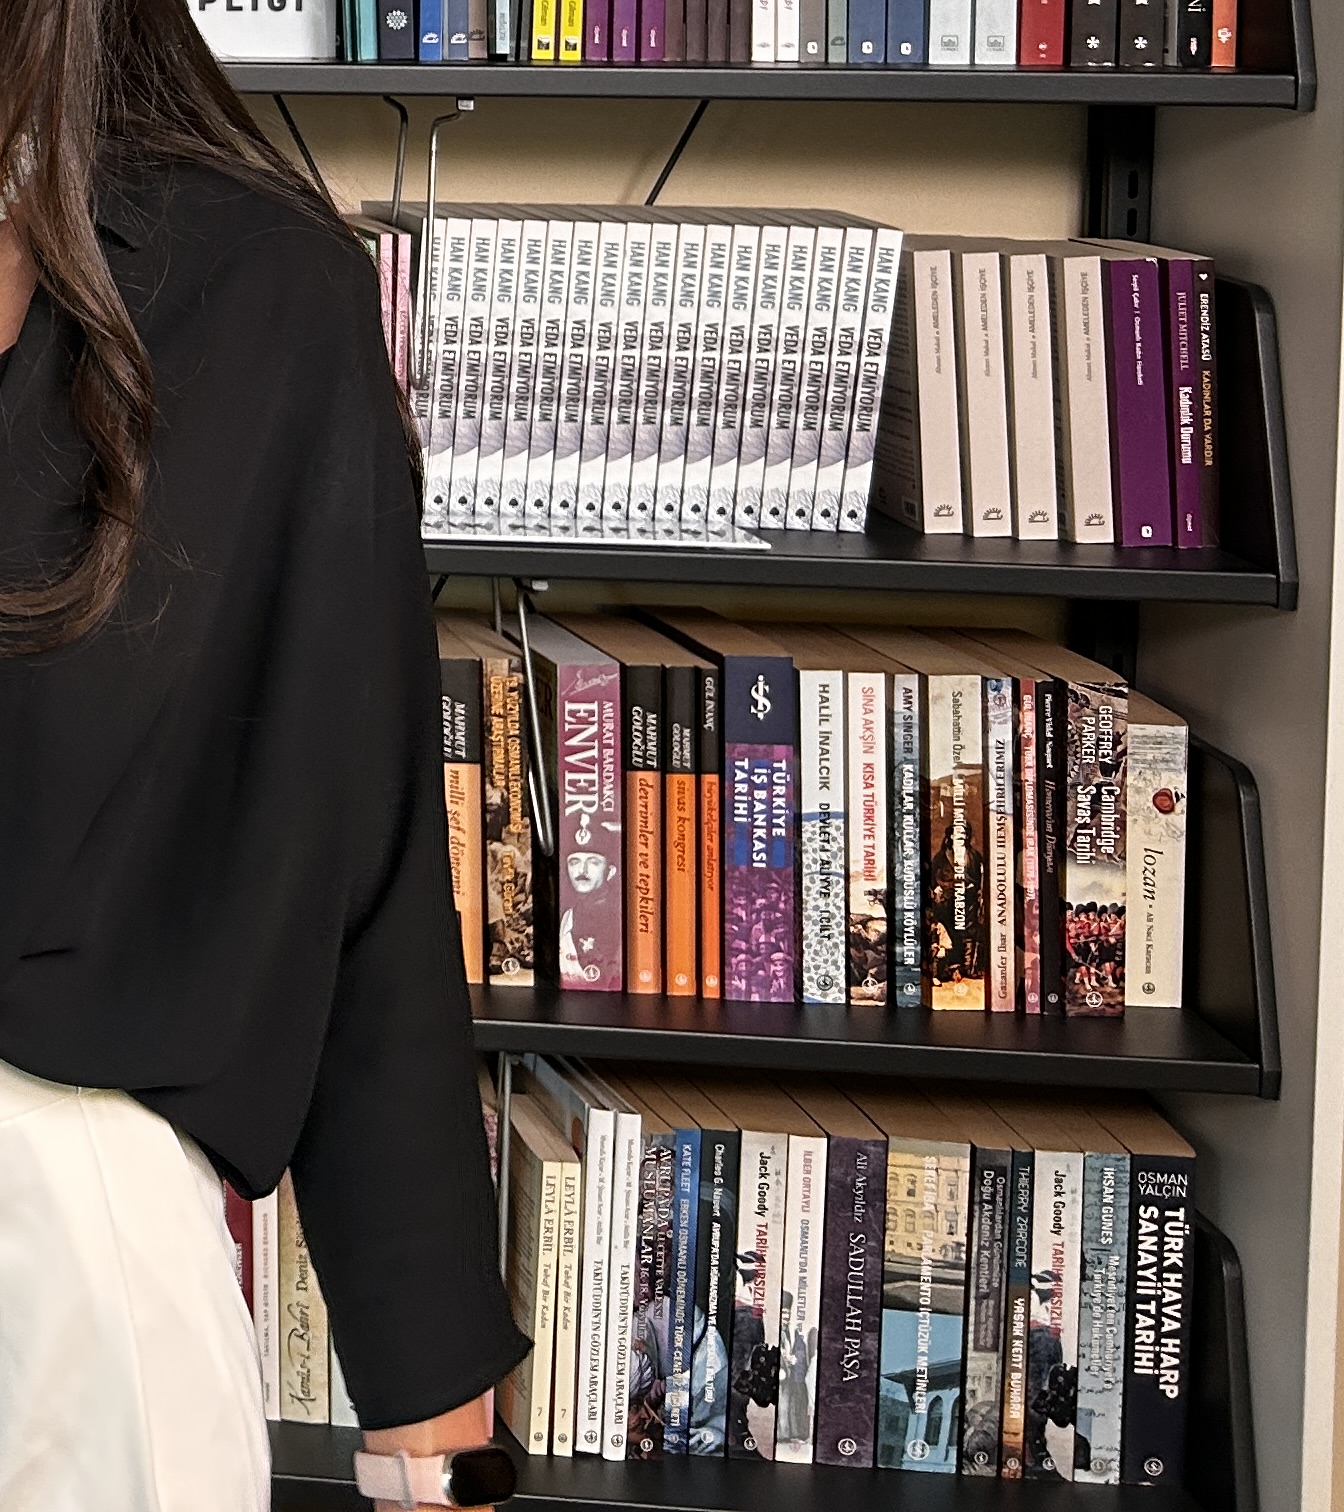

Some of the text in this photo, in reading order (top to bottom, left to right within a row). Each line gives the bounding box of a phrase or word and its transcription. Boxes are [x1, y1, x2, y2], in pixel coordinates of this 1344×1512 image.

[856, 247, 894, 433] HAN KANG VEDA ETMİYORUM
[862, 687, 876, 715] SİNA
[902, 687, 913, 754] AMY SINGER
[564, 701, 599, 816] ENVER
[601, 701, 615, 811] MURAT BARDAKÇI
[646, 713, 656, 767] MAHMUT
[818, 684, 833, 791] HALİL İNALCIK
[1081, 717, 1095, 764] PARKER
[1098, 705, 1112, 764] GEOFFREY
[734, 758, 748, 822] TARİHİ
[772, 760, 790, 837] TÜRKİYE
[862, 762, 875, 789] KISA
[749, 767, 771, 867] İŞ BANKASI
[862, 793, 877, 840] TÜRKİYE
[1074, 785, 1095, 864] Savaş Tarihi
[1098, 786, 1120, 854] Cambridge
[636, 778, 652, 933] devrimler ve tepkileri
[863, 844, 877, 882] TARİHİ
[1143, 848, 1163, 901] lozan
[856, 1152, 868, 1172] Ali
[1138, 1172, 1187, 1183] OSMAN
[1139, 1185, 1187, 1198] YALÇIN
[1050, 1170, 1066, 1236] Jack Goody
[845, 1232, 867, 1331] SADULLAH
[1133, 1205, 1161, 1375] SANAYİİ TARİHİ
[1159, 1208, 1187, 1398] TÜRK HAVA HARP
[840, 1338, 863, 1382] PAŞA
